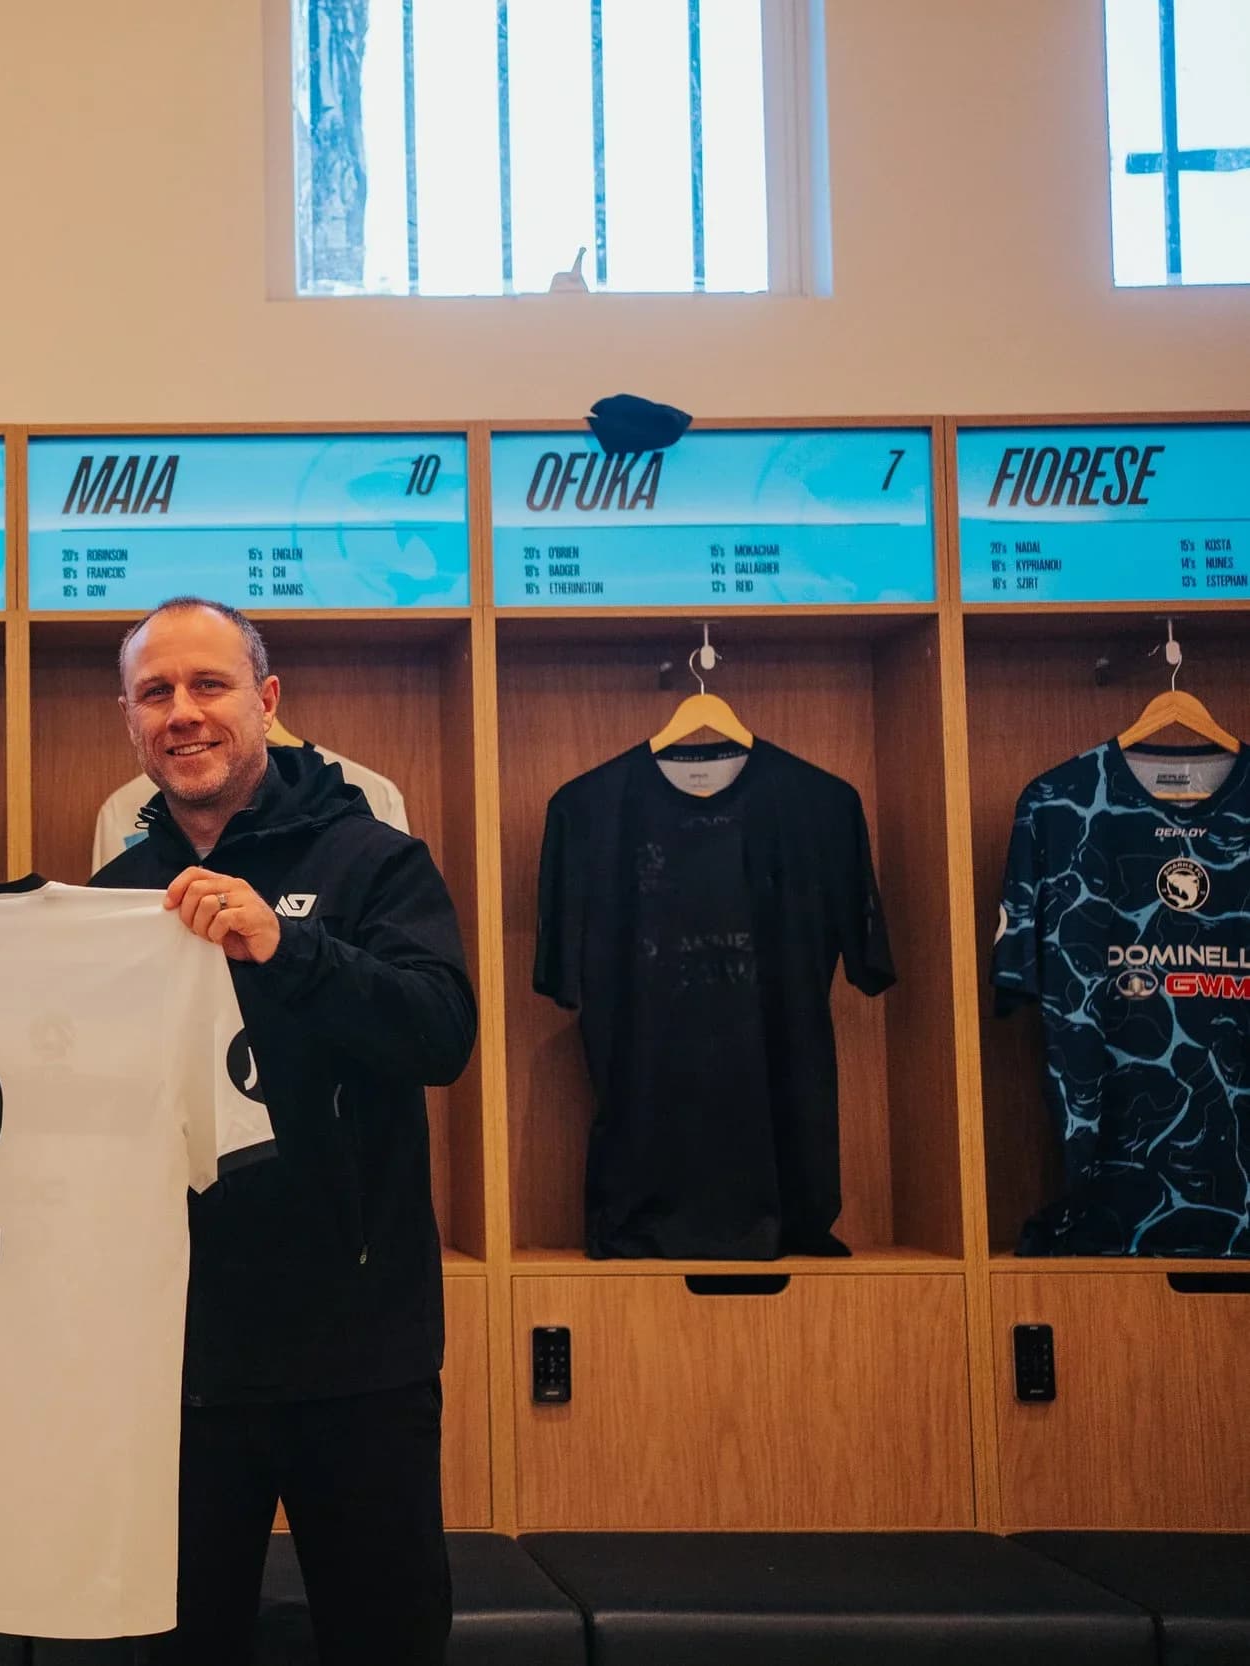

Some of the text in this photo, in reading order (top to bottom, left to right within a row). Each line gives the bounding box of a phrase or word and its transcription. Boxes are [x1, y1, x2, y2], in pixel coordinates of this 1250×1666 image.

[405, 454, 441, 496] 10
[881, 450, 905, 491] 7
[988, 445, 1165, 507] FIORESE
[62, 455, 179, 514] MAIA
[525, 451, 665, 511] OFUKA
[1180, 539, 1231, 552] 15's KOSTA
[62, 549, 128, 561] 20's ROBINSON
[249, 548, 263, 560] 15's
[524, 547, 540, 559] 20's
[735, 562, 779, 574] GALLAGHER
[1181, 557, 1234, 569] 14's NUNES
[87, 567, 126, 578] FRANCOIS
[249, 566, 286, 578] 14's CHI
[549, 564, 580, 576] BADGER
[1182, 575, 1248, 587] 13's ESTEPHAN
[87, 585, 106, 597] GOW
[249, 584, 303, 595] 13's MANNS
[550, 582, 603, 594] ETHERINGTON
[1155, 827, 1207, 839] DEPLOY
[1165, 973, 1250, 997] GWM
